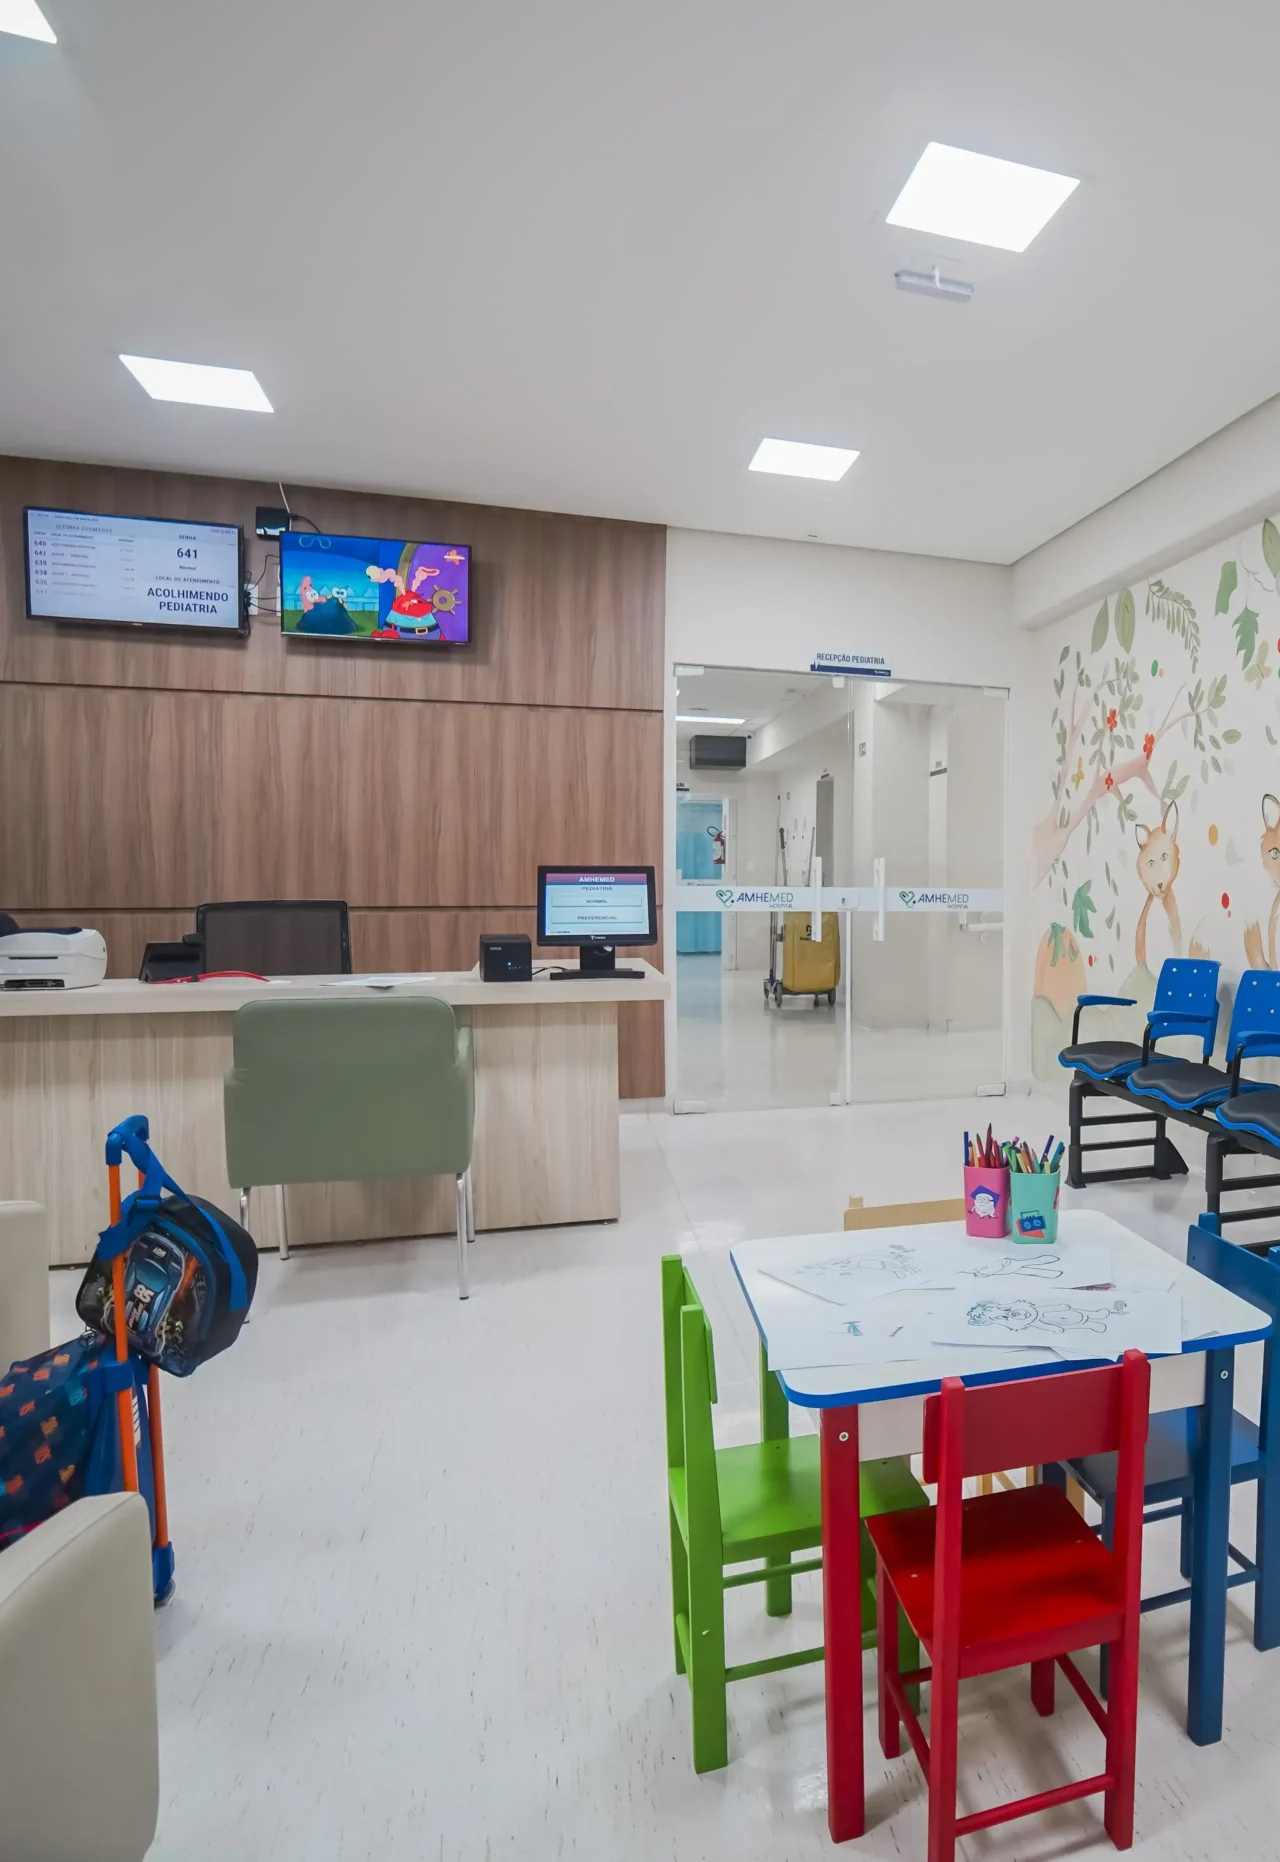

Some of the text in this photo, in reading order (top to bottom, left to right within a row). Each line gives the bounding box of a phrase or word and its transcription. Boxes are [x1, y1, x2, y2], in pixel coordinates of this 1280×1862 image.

[176, 548, 198, 559] 641
[183, 577, 220, 585] ATENDIMENTO
[147, 587, 229, 602] ACOLHIMENDO
[159, 601, 218, 614] PEDIATRIA
[816, 652, 885, 665] RECEPÇÃO PEDIATRIA
[736, 892, 794, 903] AMHEMED
[917, 893, 970, 904] AMHEMED
[134, 1284, 155, 1303] 85
